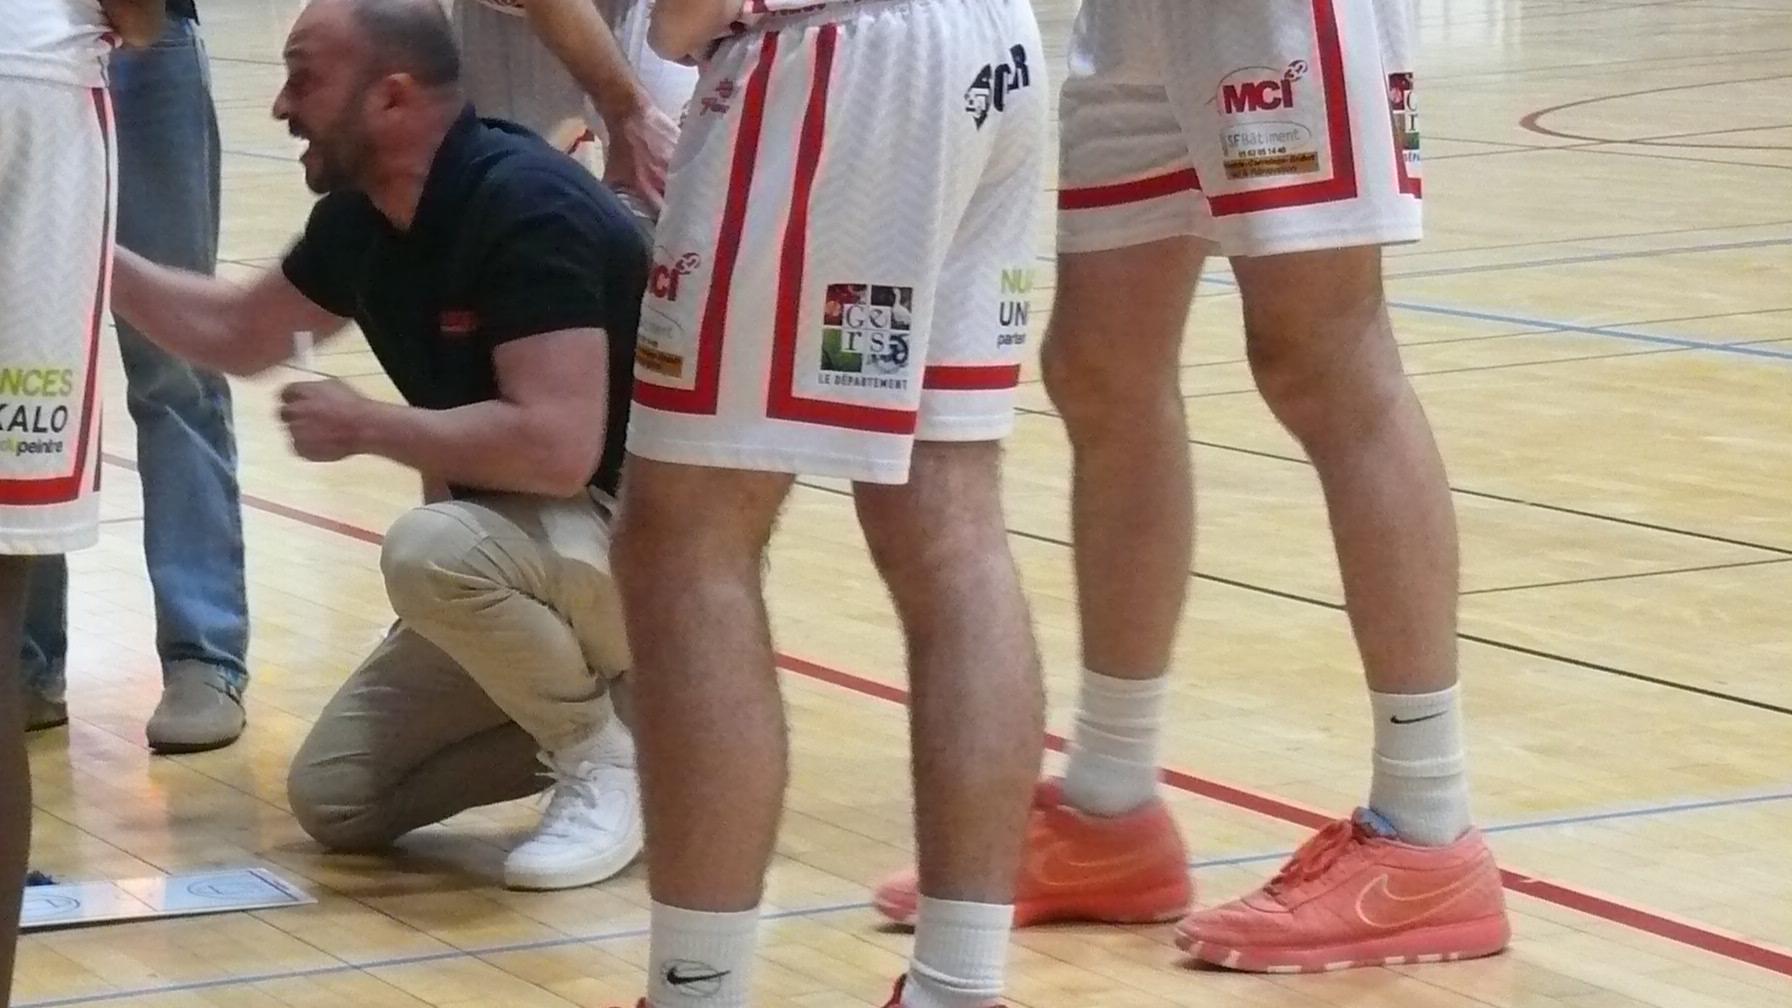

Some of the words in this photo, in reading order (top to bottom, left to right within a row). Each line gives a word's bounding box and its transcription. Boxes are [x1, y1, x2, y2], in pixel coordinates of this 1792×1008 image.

[1222, 78, 1294, 114] MCI
[649, 264, 681, 302] CI
[1000, 269, 1032, 294] NU
[999, 301, 1029, 326] UN
